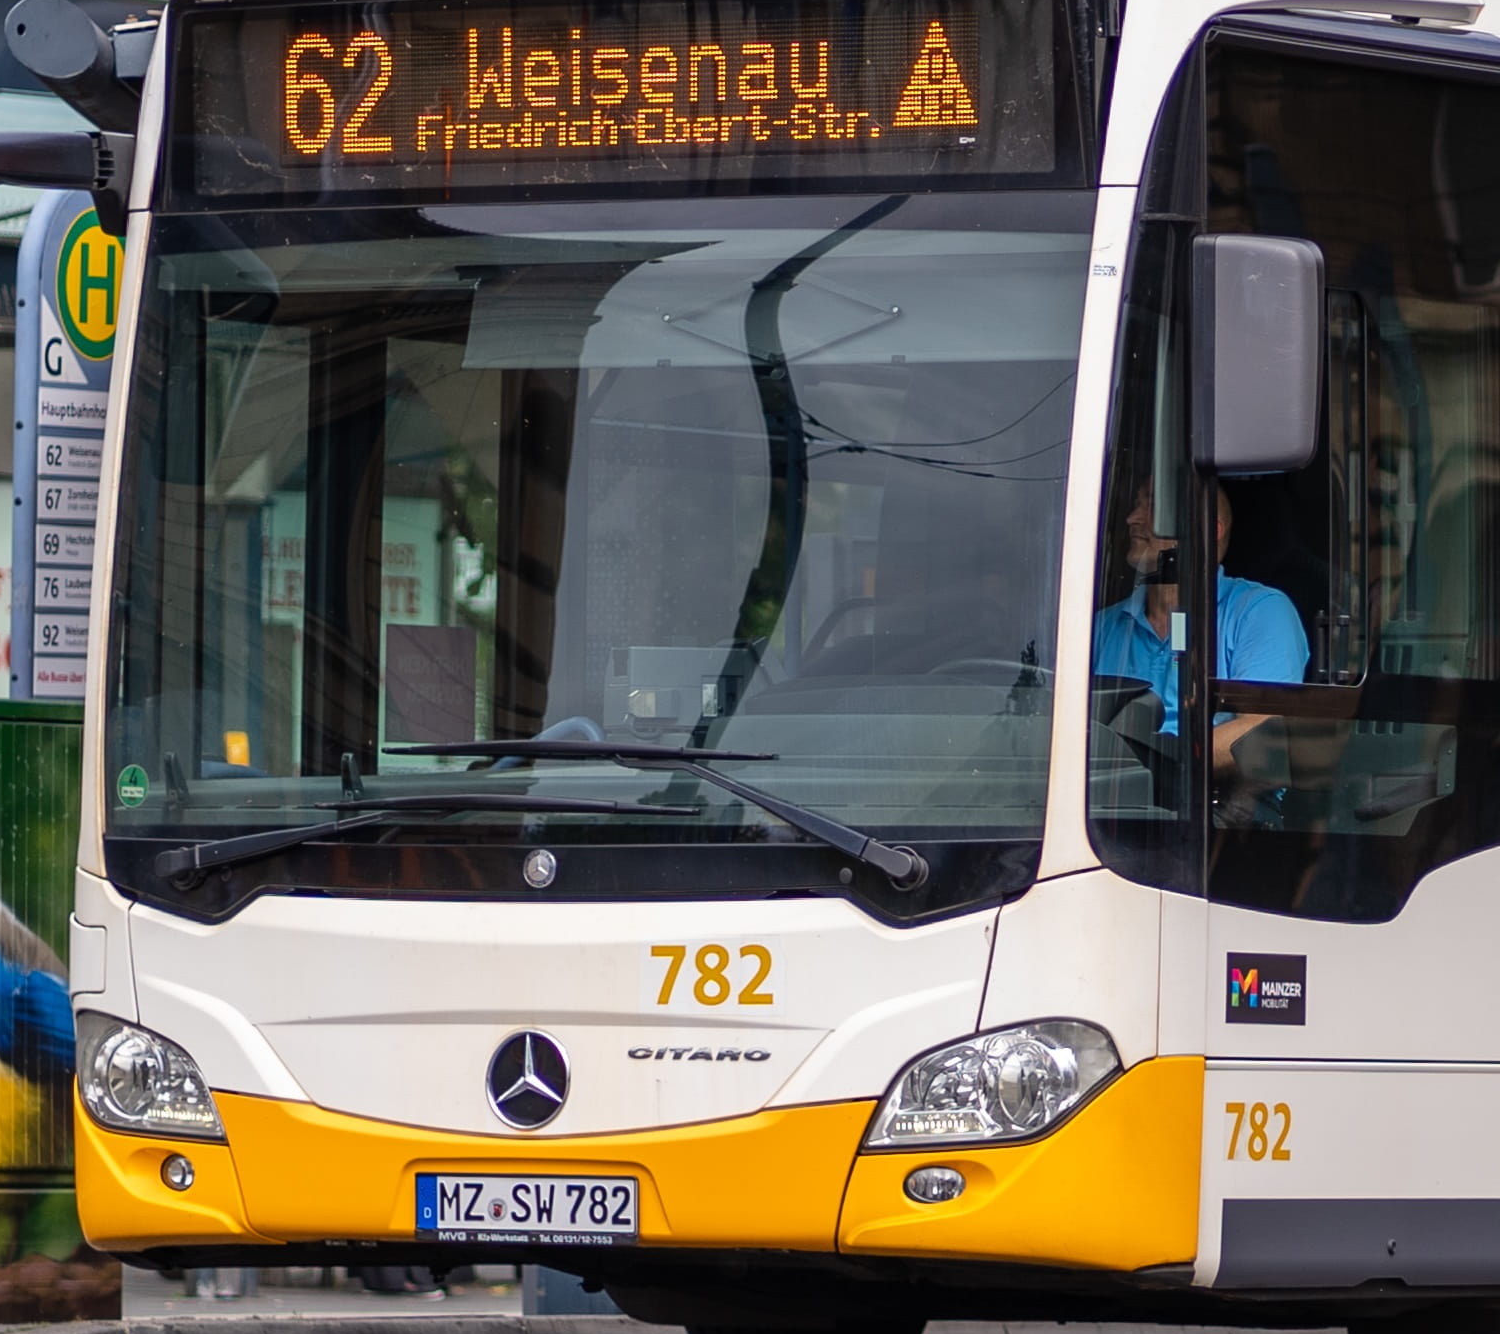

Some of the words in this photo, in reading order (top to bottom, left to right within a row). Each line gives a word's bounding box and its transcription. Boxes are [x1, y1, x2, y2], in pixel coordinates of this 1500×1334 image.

[286, 31, 393, 154] 62
[468, 27, 828, 109] Weisenau
[417, 103, 882, 151] Friedrich-Ebert-Str.
[79, 242, 115, 325] H
[45, 337, 62, 376] G
[41, 403, 106, 421] Hauptbahnho
[46, 445, 62, 466] 62
[45, 488, 62, 510] 67
[44, 533, 60, 555] 69
[43, 577, 59, 599] 76
[43, 624, 59, 646] 92
[650, 943, 774, 1006] 782
[1261, 981, 1302, 997] MAINZER
[1261, 998, 1289, 1009] MOBILITÄT
[627, 1046, 772, 1062] CITARO
[1225, 1102, 1292, 1161] 782
[423, 1207, 432, 1218] D
[439, 1183, 485, 1221] MZ
[510, 1184, 555, 1224] SW
[566, 1185, 631, 1226] 782
[438, 1231, 467, 1242] MVG
